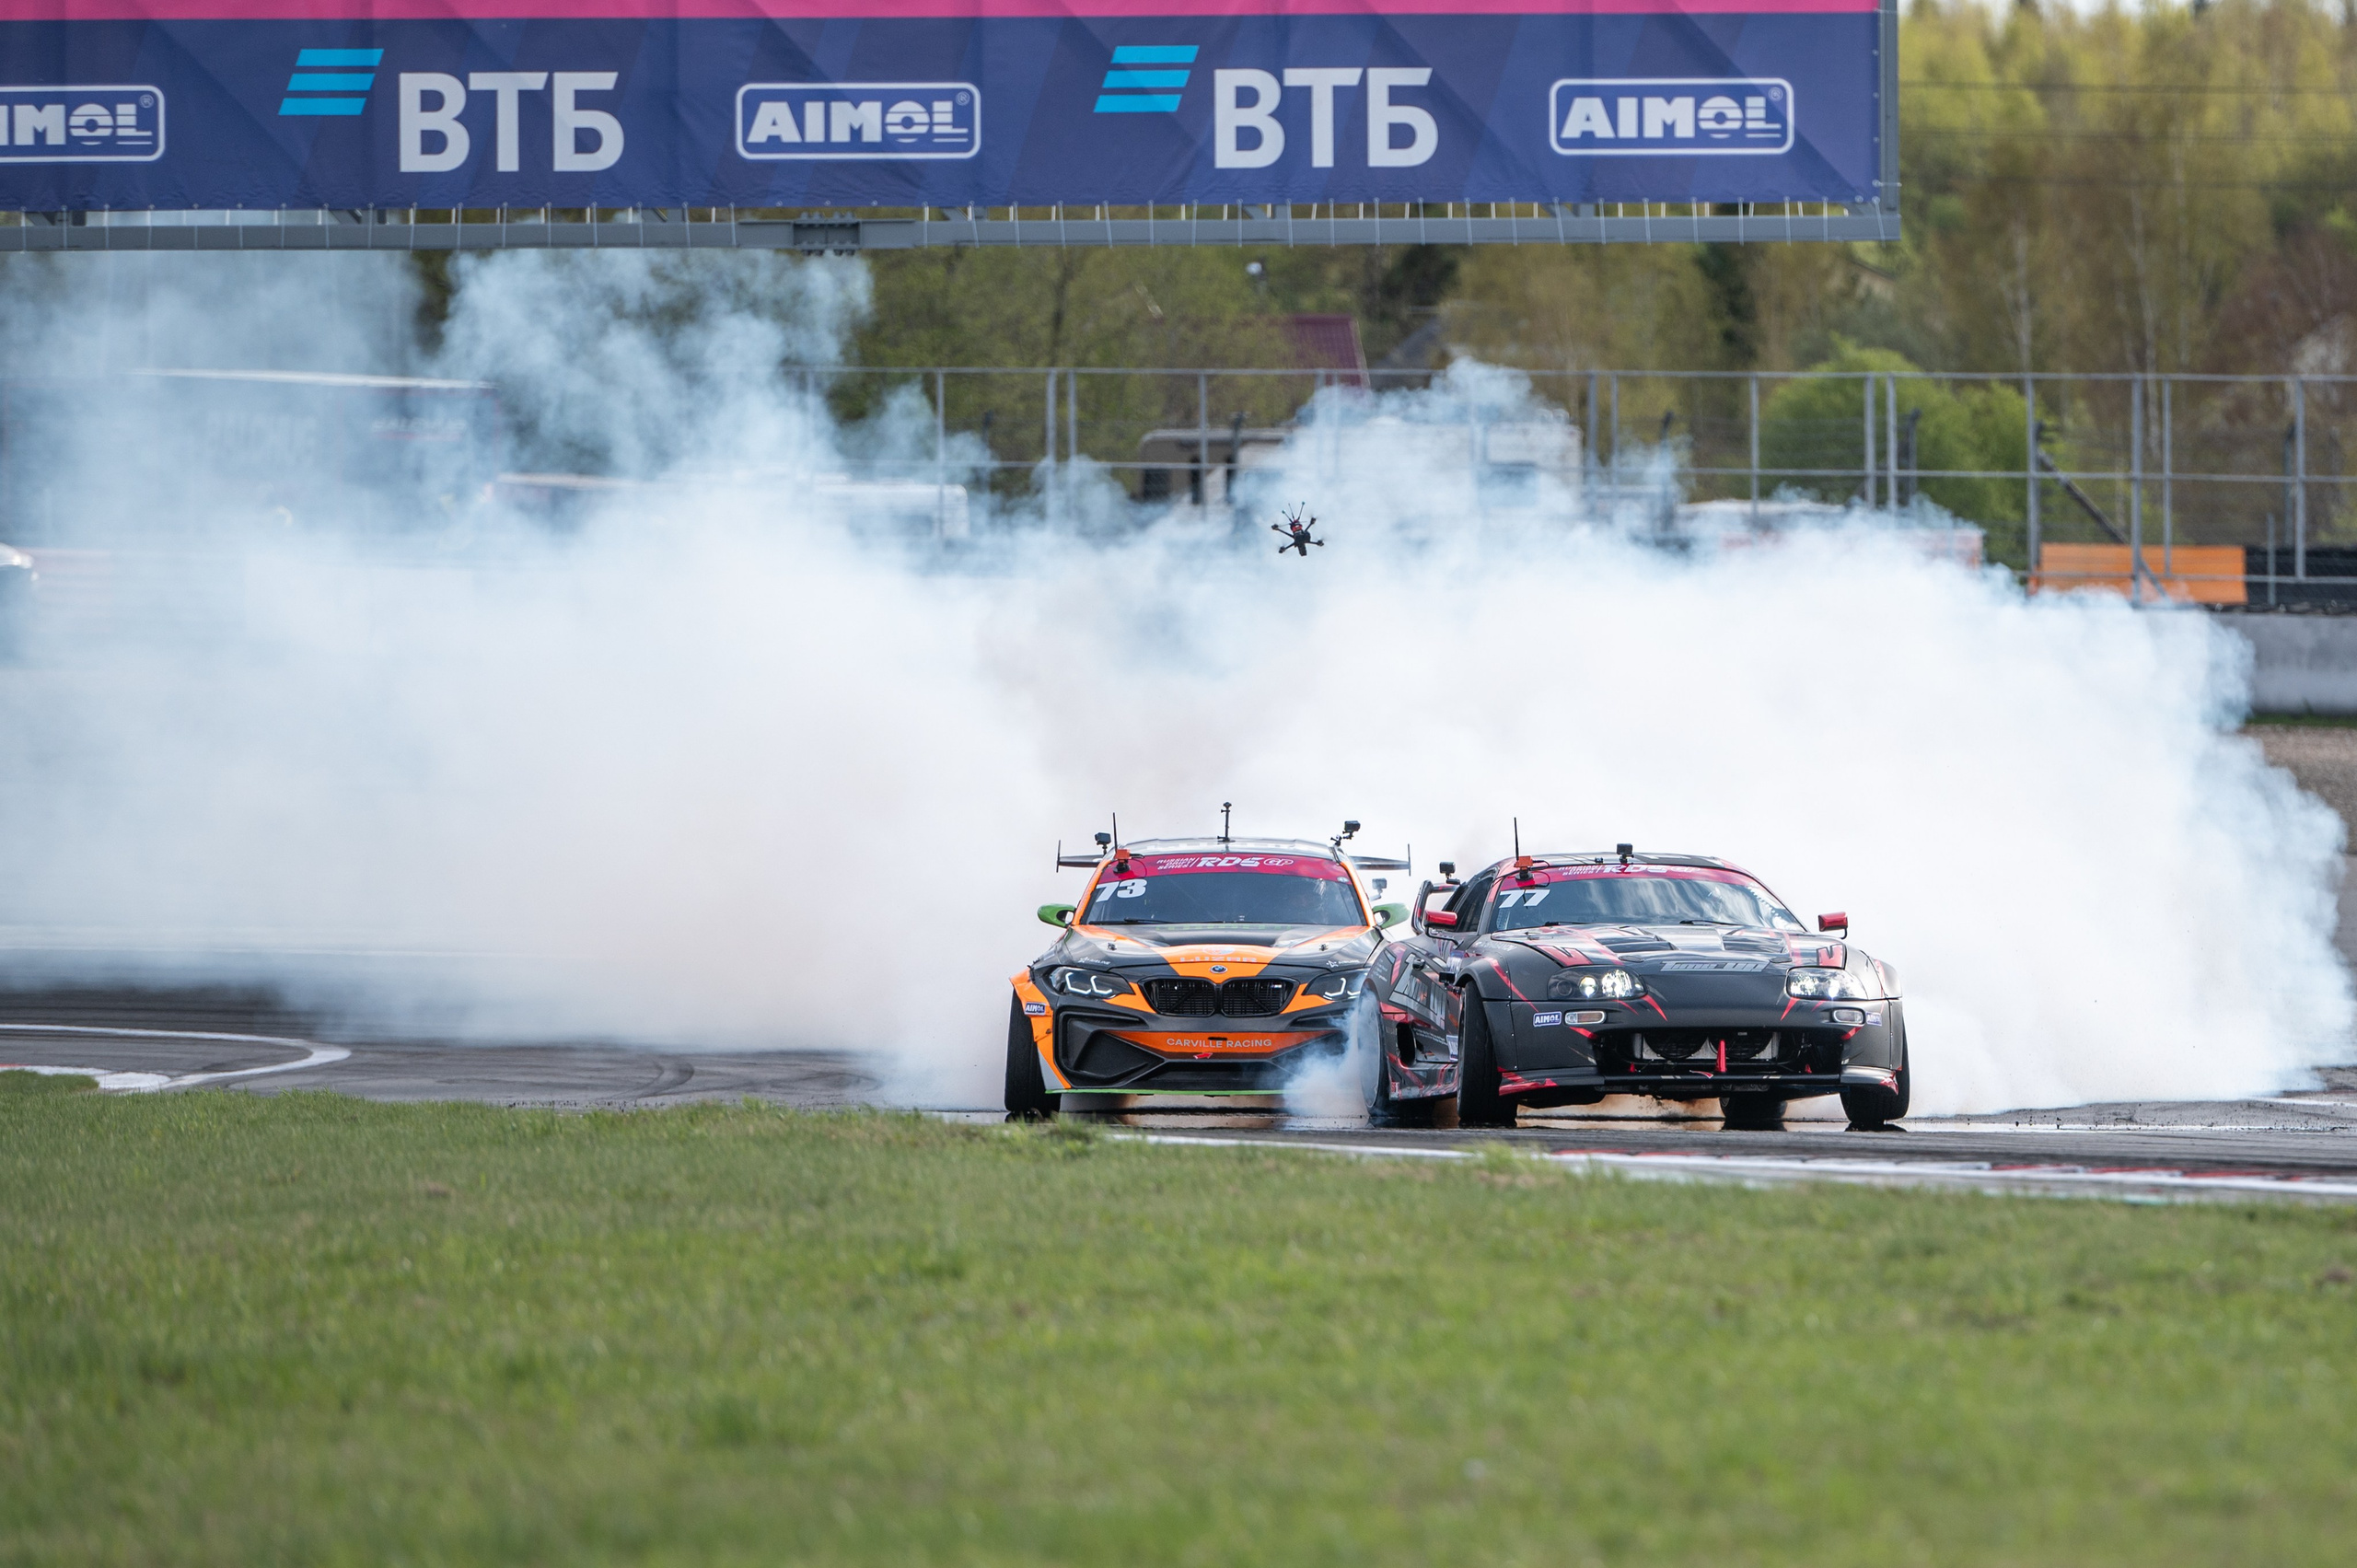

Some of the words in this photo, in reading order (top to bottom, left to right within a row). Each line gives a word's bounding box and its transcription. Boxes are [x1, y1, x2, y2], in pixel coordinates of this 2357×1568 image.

[400, 72, 624, 172] ВТБ
[746, 100, 969, 144] AIMOL
[1213, 67, 1438, 168] ВТБ
[1560, 96, 1782, 138] AIMOL
[1197, 856, 1264, 867] RDS
[1096, 878, 1147, 902] 73
[1499, 889, 1550, 909] 77
[1535, 1014, 1560, 1024] AIMOL
[1167, 1038, 1222, 1048] CARVILLE
[1226, 1039, 1271, 1048] RACING
